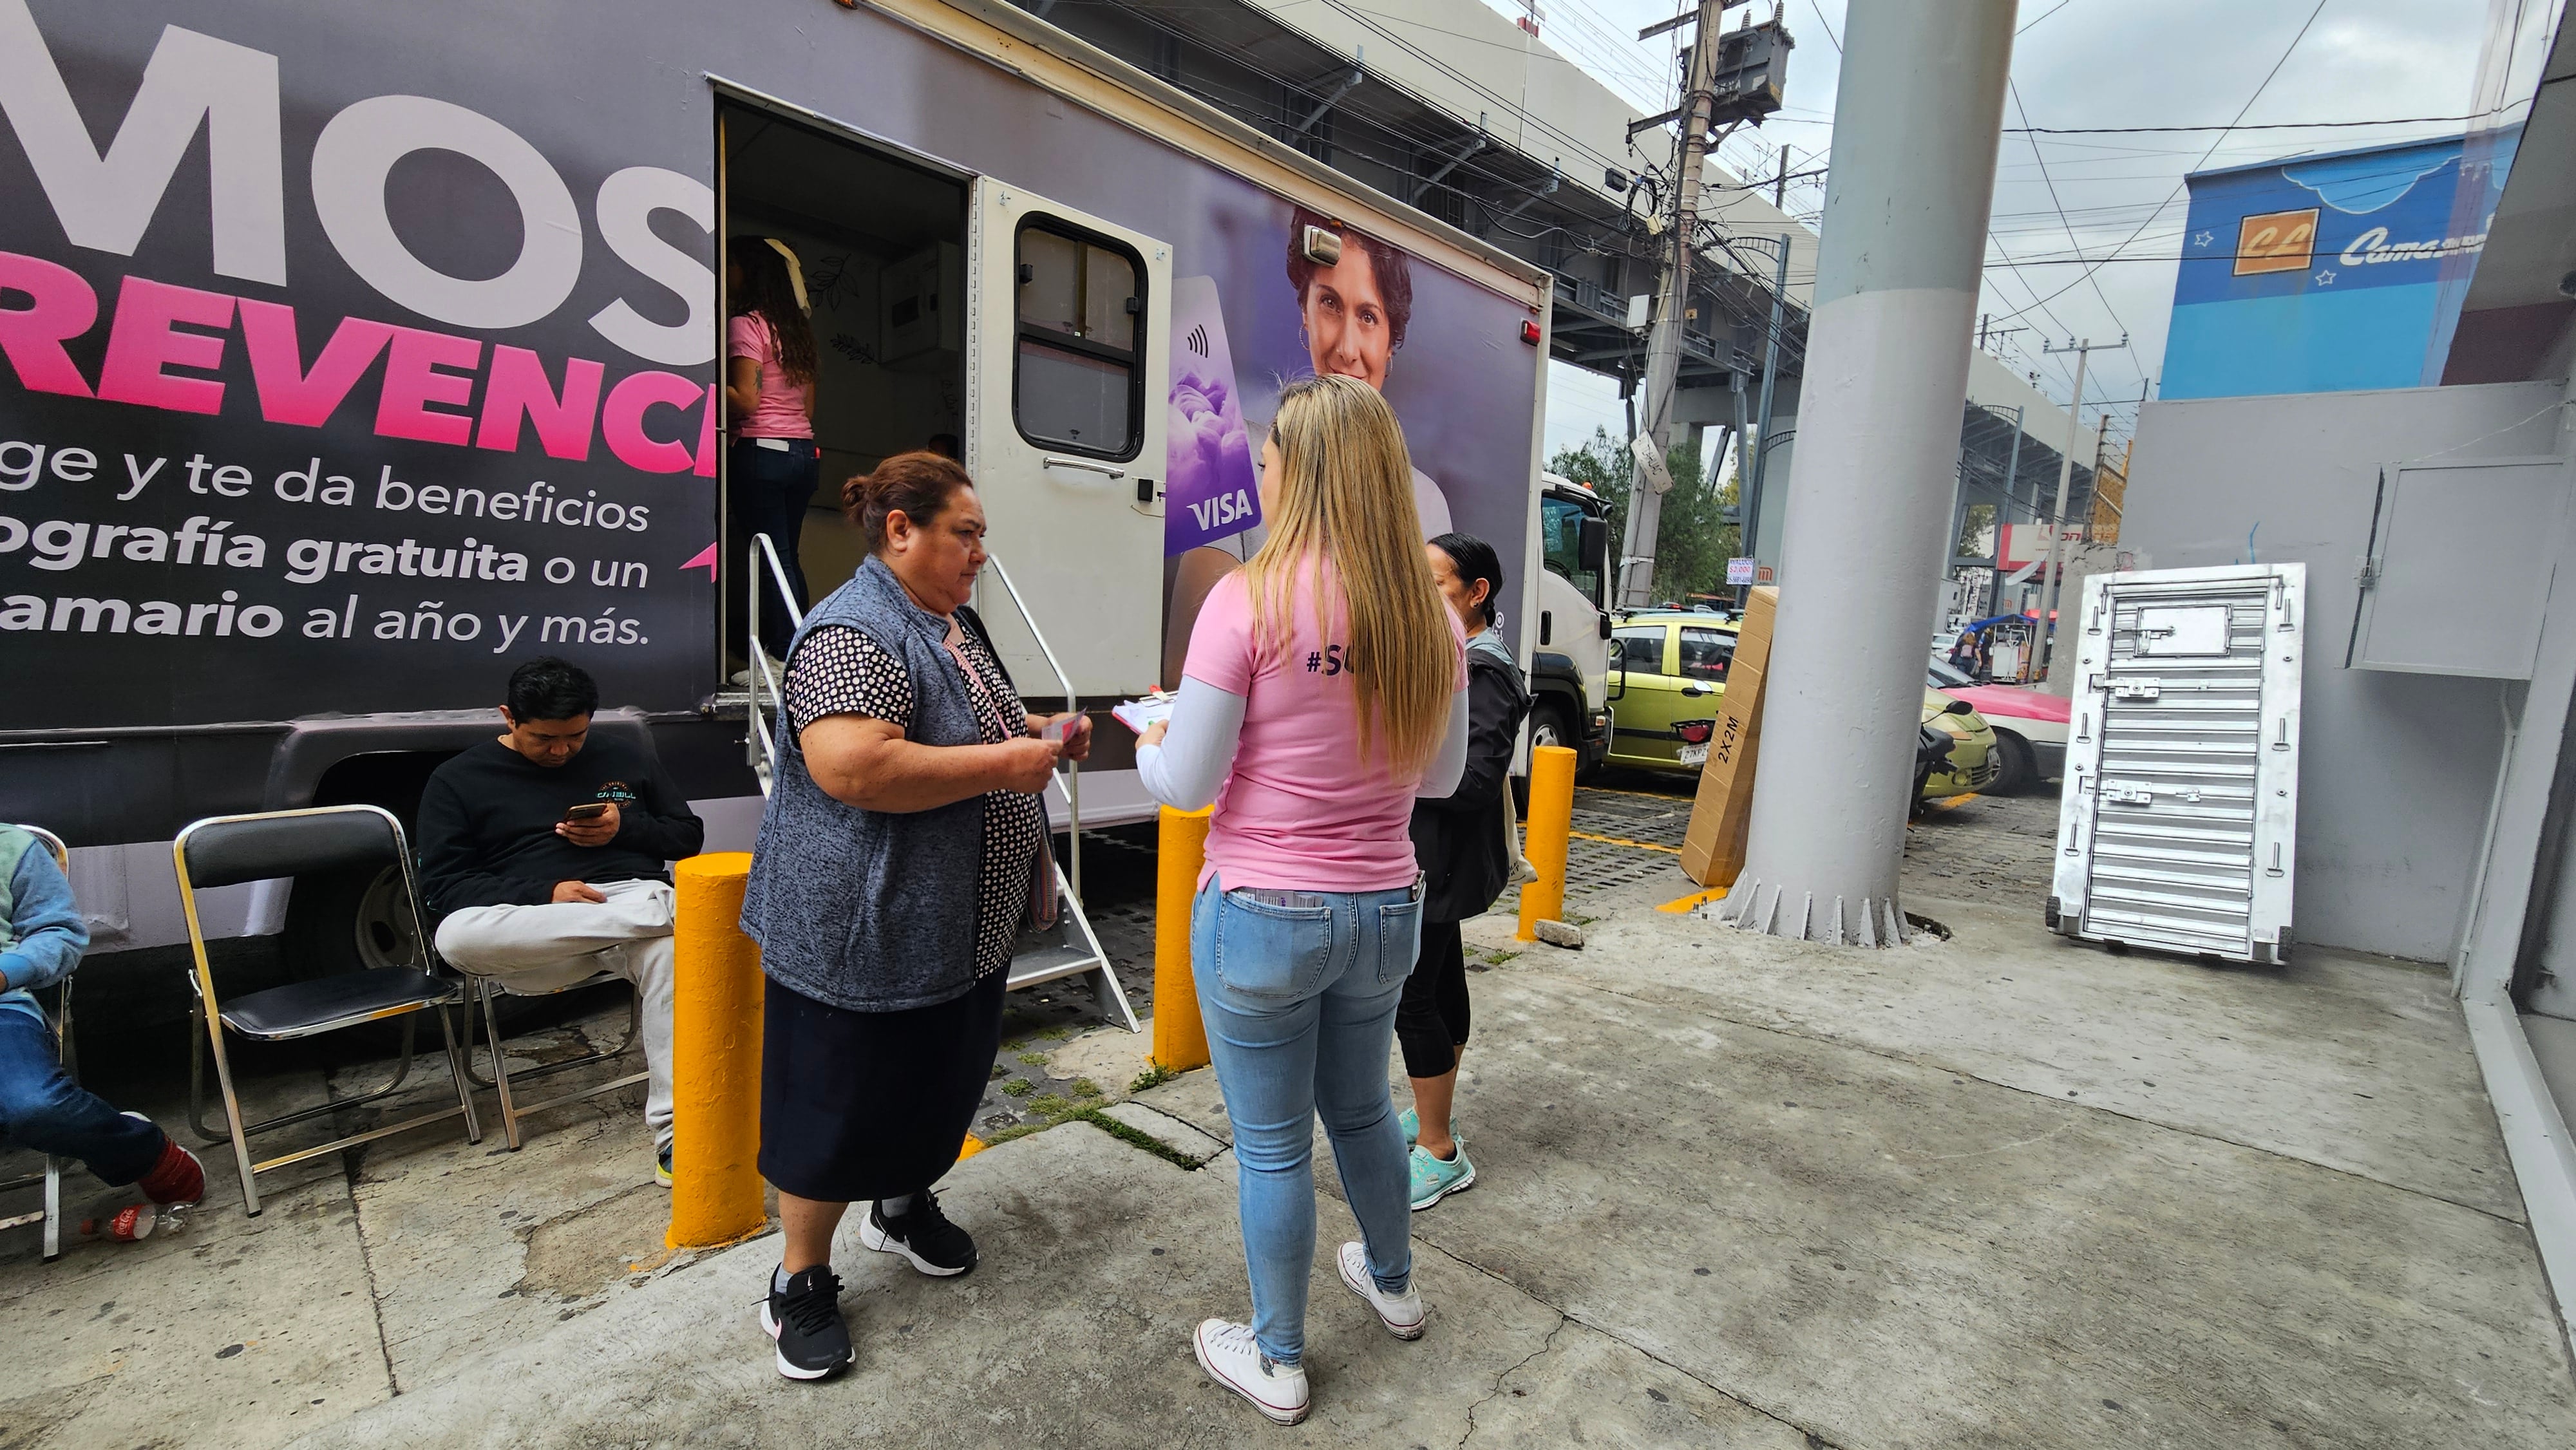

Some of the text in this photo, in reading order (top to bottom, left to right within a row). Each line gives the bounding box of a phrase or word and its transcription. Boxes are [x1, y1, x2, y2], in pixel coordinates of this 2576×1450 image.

[0, 441, 649, 532] ge y te da beneficios
[1186, 489, 1253, 531] VISA
[284, 538, 527, 583] gratuita
[545, 558, 575, 584] o
[592, 560, 647, 588] un
[0, 590, 649, 653] amario al año y más.
